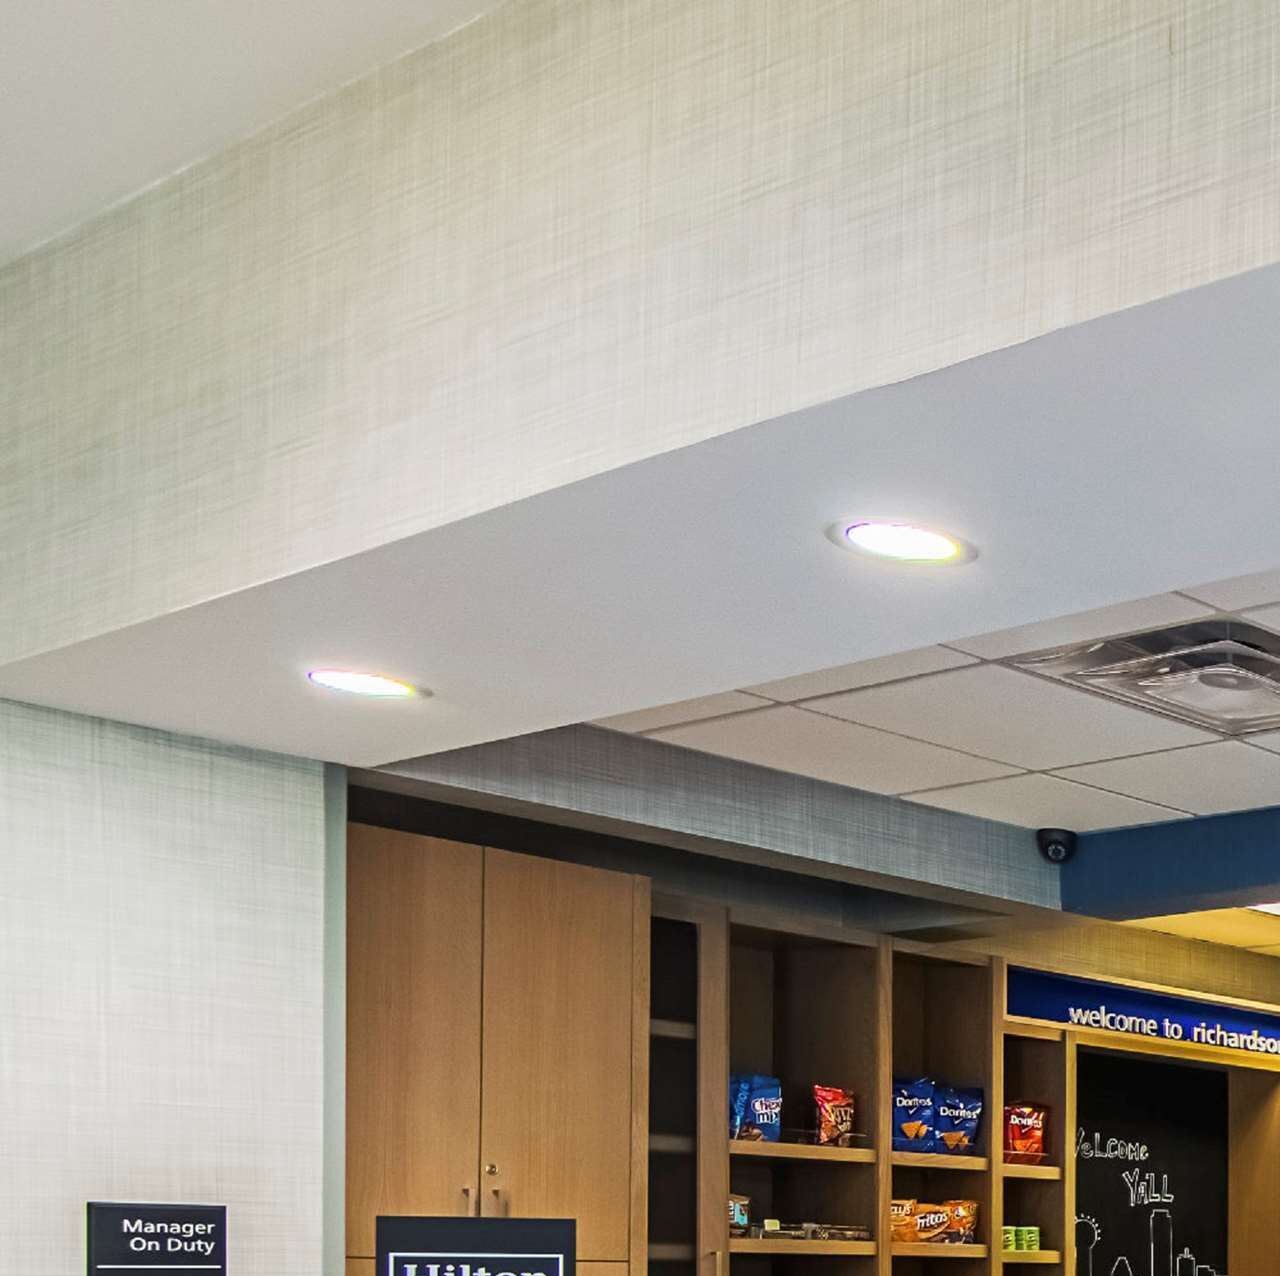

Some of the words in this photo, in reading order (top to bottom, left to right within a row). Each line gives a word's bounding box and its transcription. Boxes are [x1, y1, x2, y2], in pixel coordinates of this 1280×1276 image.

[1068, 1005, 1158, 1036] welcome
[1163, 1018, 1183, 1040] to
[896, 1097, 932, 1107] Doritos
[939, 1106, 981, 1119] Doritos
[1010, 1114, 1043, 1128] Doritos
[122, 1218, 216, 1238] Manager
[915, 1212, 948, 1230] Fritos
[129, 1236, 160, 1252] On
[167, 1237, 216, 1256] Duty
